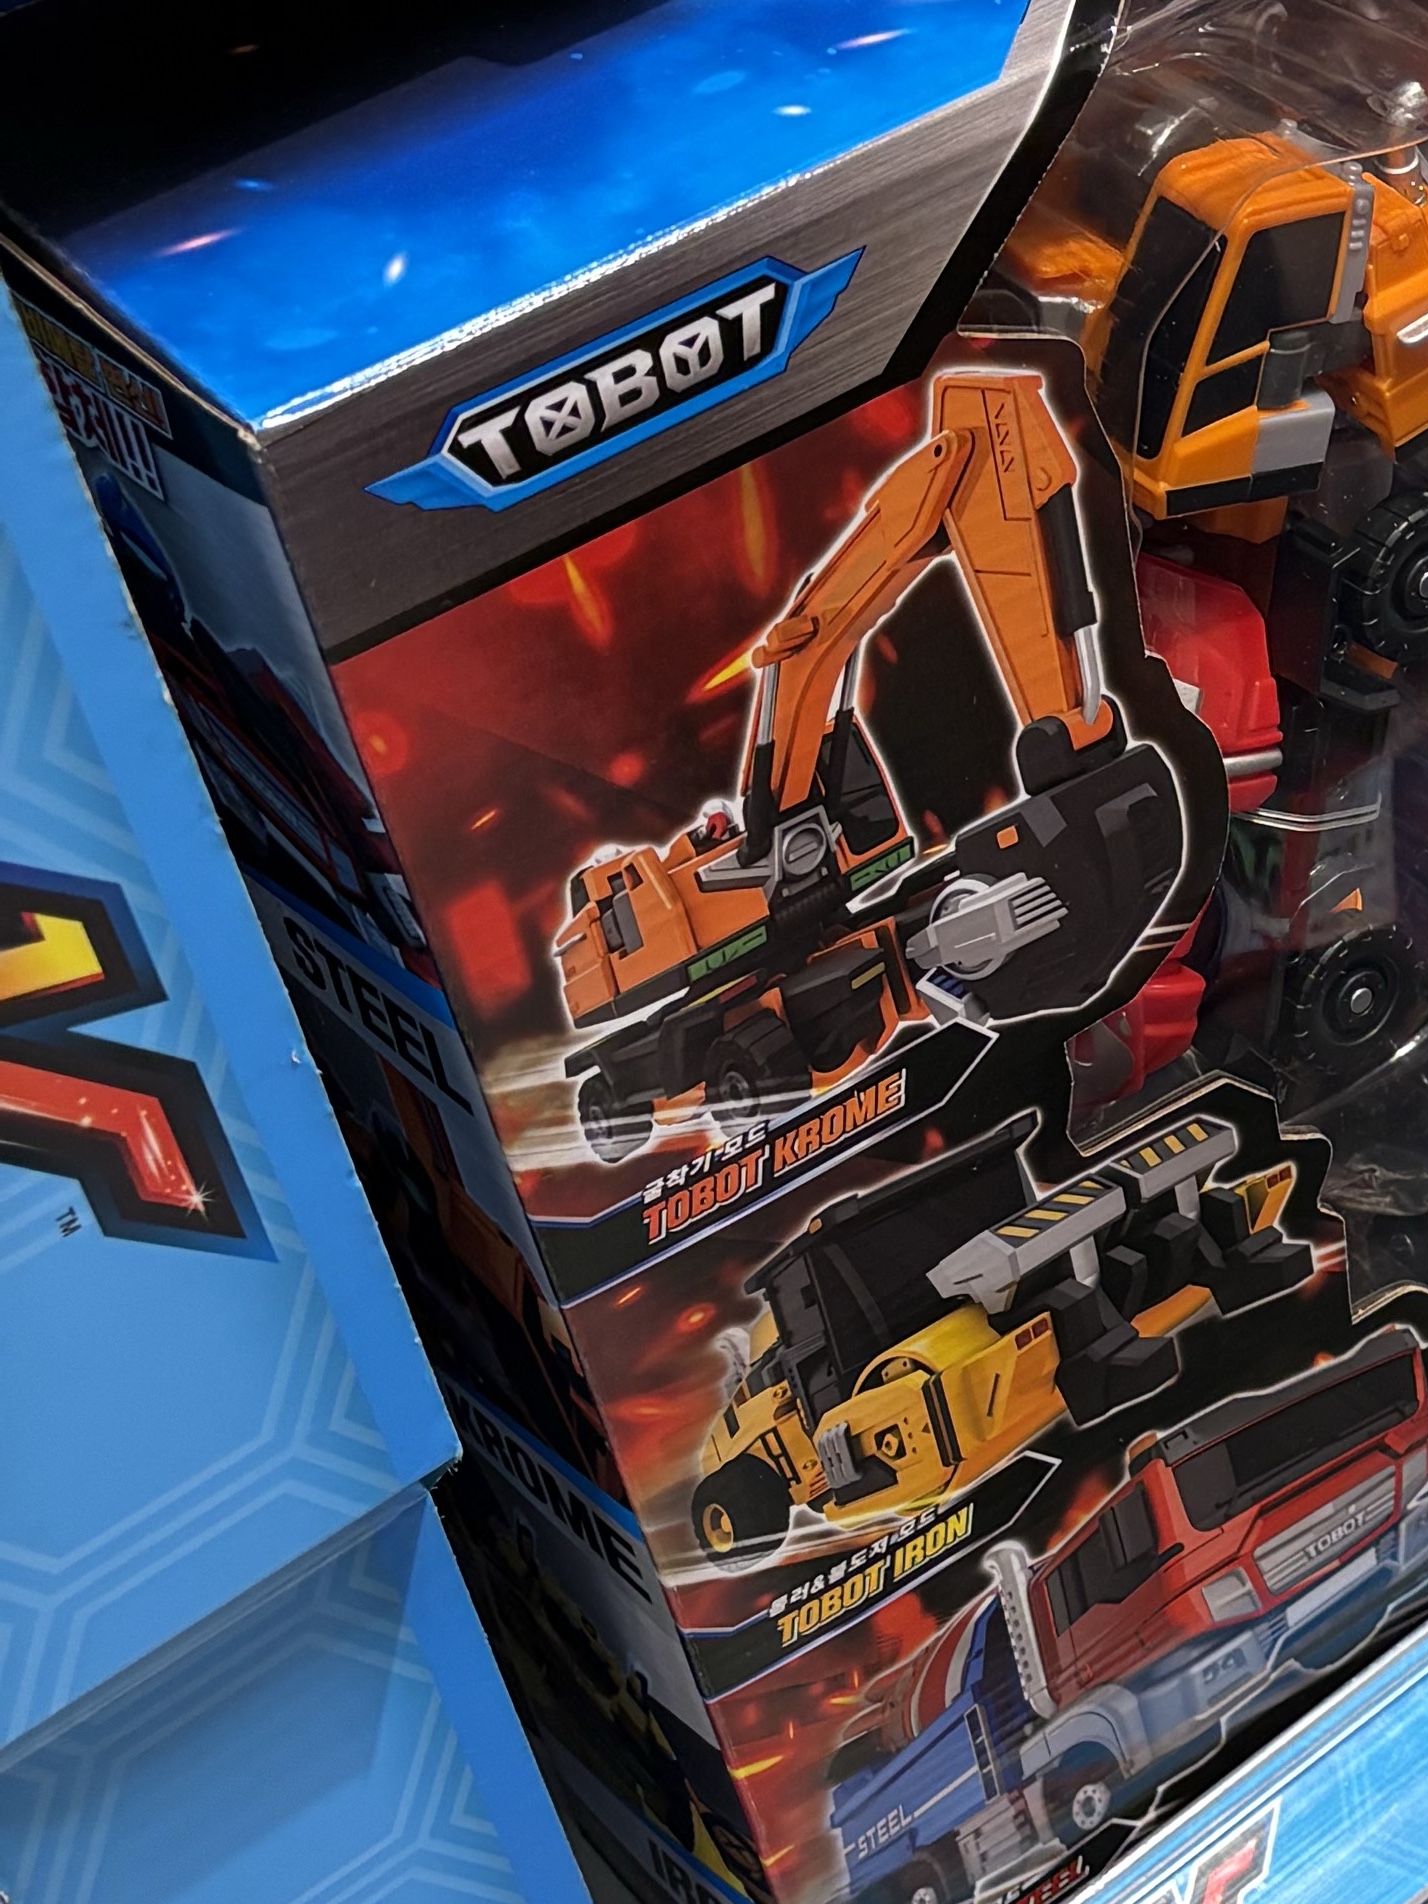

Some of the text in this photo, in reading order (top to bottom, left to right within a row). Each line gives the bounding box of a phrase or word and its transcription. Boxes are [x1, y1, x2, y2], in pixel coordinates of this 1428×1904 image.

[458, 282, 779, 486] TOBOT
[282, 911, 476, 1119] STEEL
[642, 1068, 906, 1245] TOBOT KROME
[452, 1387, 656, 1606] KROME
[777, 1502, 975, 1648] TOBOT IRON
[1303, 1509, 1370, 1559] TOBOT
[857, 1805, 913, 1860] STEEL
